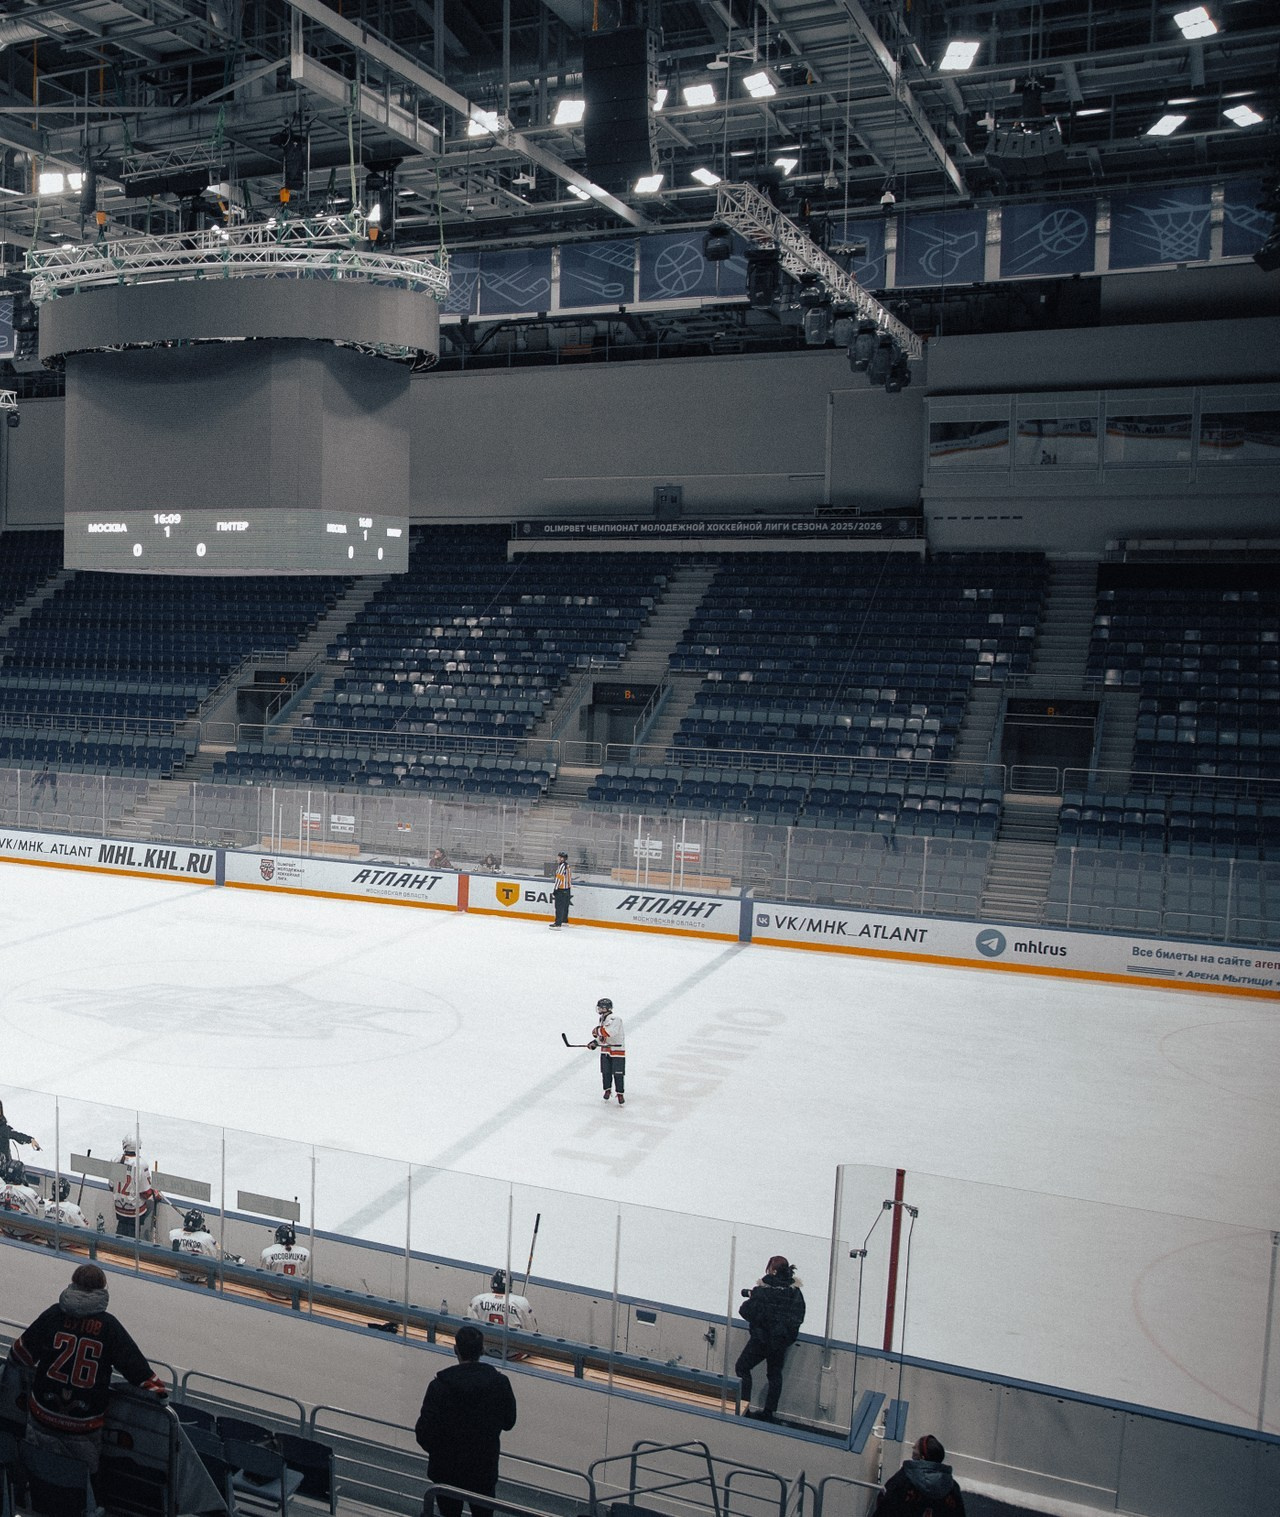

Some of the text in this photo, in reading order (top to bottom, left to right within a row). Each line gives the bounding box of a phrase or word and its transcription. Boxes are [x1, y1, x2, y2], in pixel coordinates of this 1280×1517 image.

[153, 513, 182, 525] 16:09
[216, 521, 249, 532] ПИТЕР
[88, 523, 128, 533] МОСКВА
[163, 525, 171, 538] 1
[544, 521, 882, 533] OLIMPBET ЧЕМПИОНАТ МОЛОДЕЖНОЙ ХОККЕЙНОЙ ЛИГИ СЕЗОНА 2025/2026
[363, 529, 368, 541] 1
[132, 543, 143, 557] 0
[196, 542, 206, 557] 0
[97, 843, 214, 874] MHL.KHL.RU
[351, 868, 443, 891] АТЛАНТ
[616, 895, 723, 919] АТЛАНТ
[775, 915, 928, 943] VK/MHK_ATLANT
[1014, 940, 1067, 957] mhlrus
[1132, 946, 1153, 957] Все
[1155, 948, 1197, 962] билеты
[1200, 954, 1214, 964] на
[1217, 955, 1251, 968] сайте
[47, 1331, 103, 1389] 26
